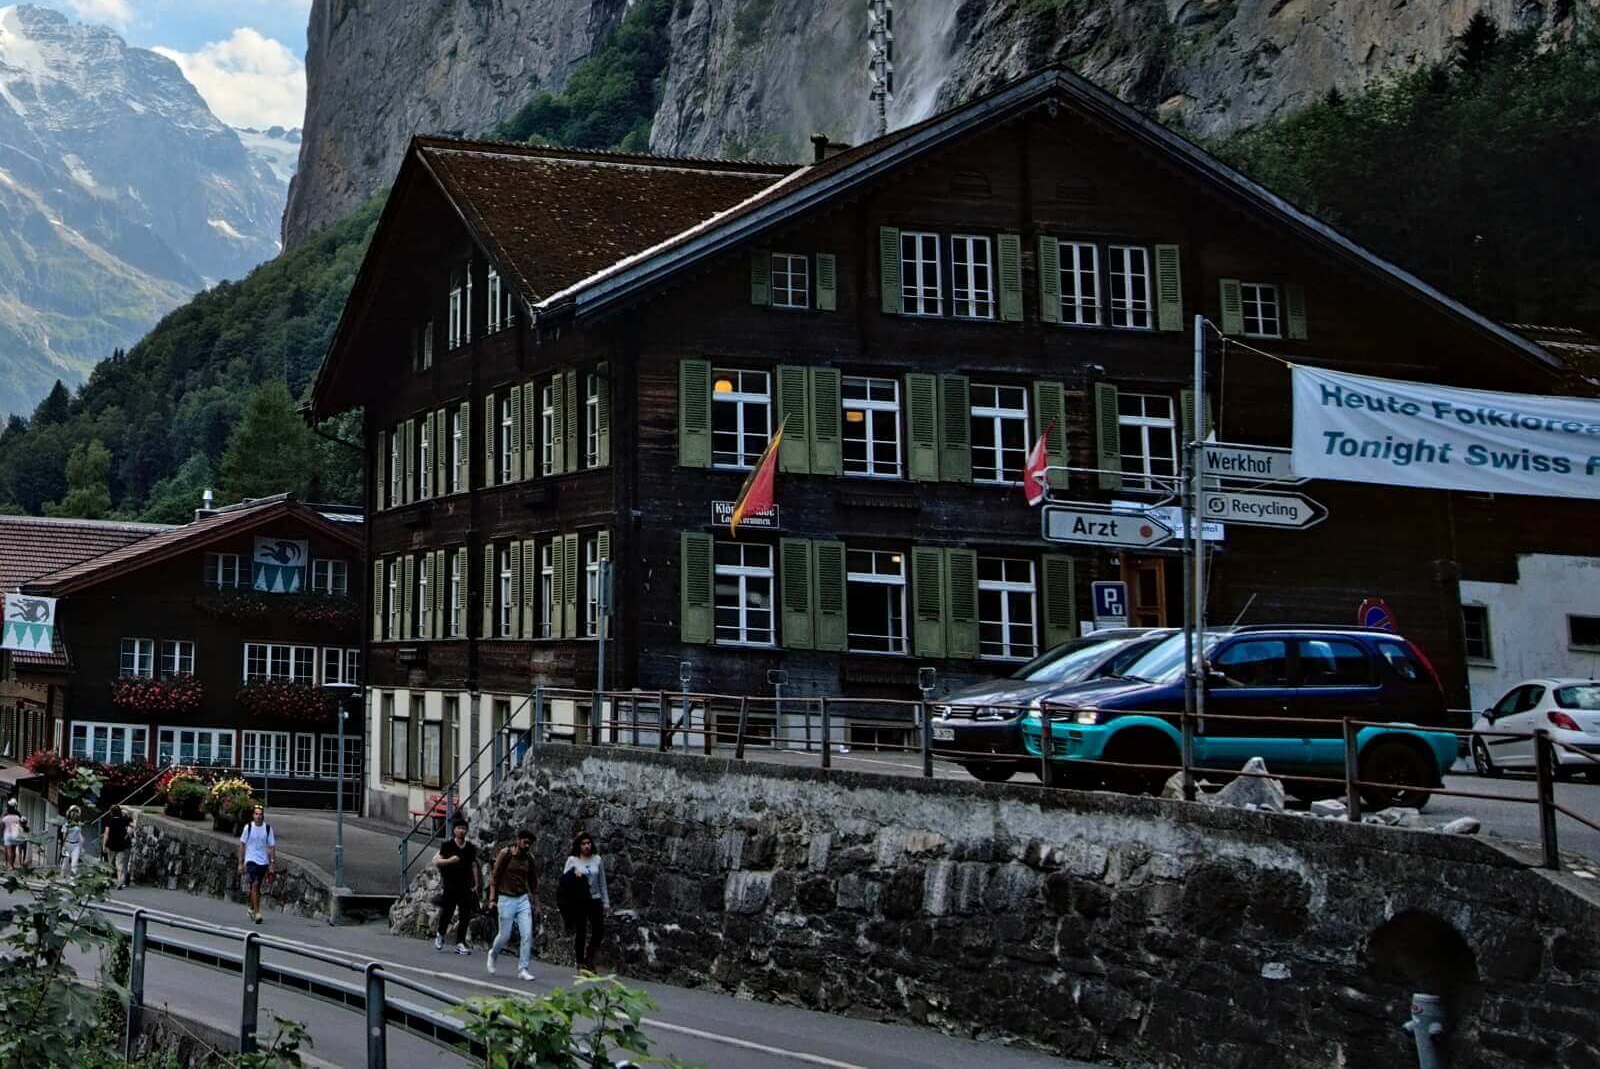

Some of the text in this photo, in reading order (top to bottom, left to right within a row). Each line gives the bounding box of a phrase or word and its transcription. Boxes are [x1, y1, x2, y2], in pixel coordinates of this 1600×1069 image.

[1320, 383, 1421, 417] Heute
[1206, 450, 1273, 474] Werkhof
[1323, 430, 1453, 466] Tonight
[1464, 443, 1572, 475] Swiss
[1232, 498, 1298, 520] Recycling
[1072, 516, 1119, 537] Arzt
[1103, 587, 1118, 609] P
